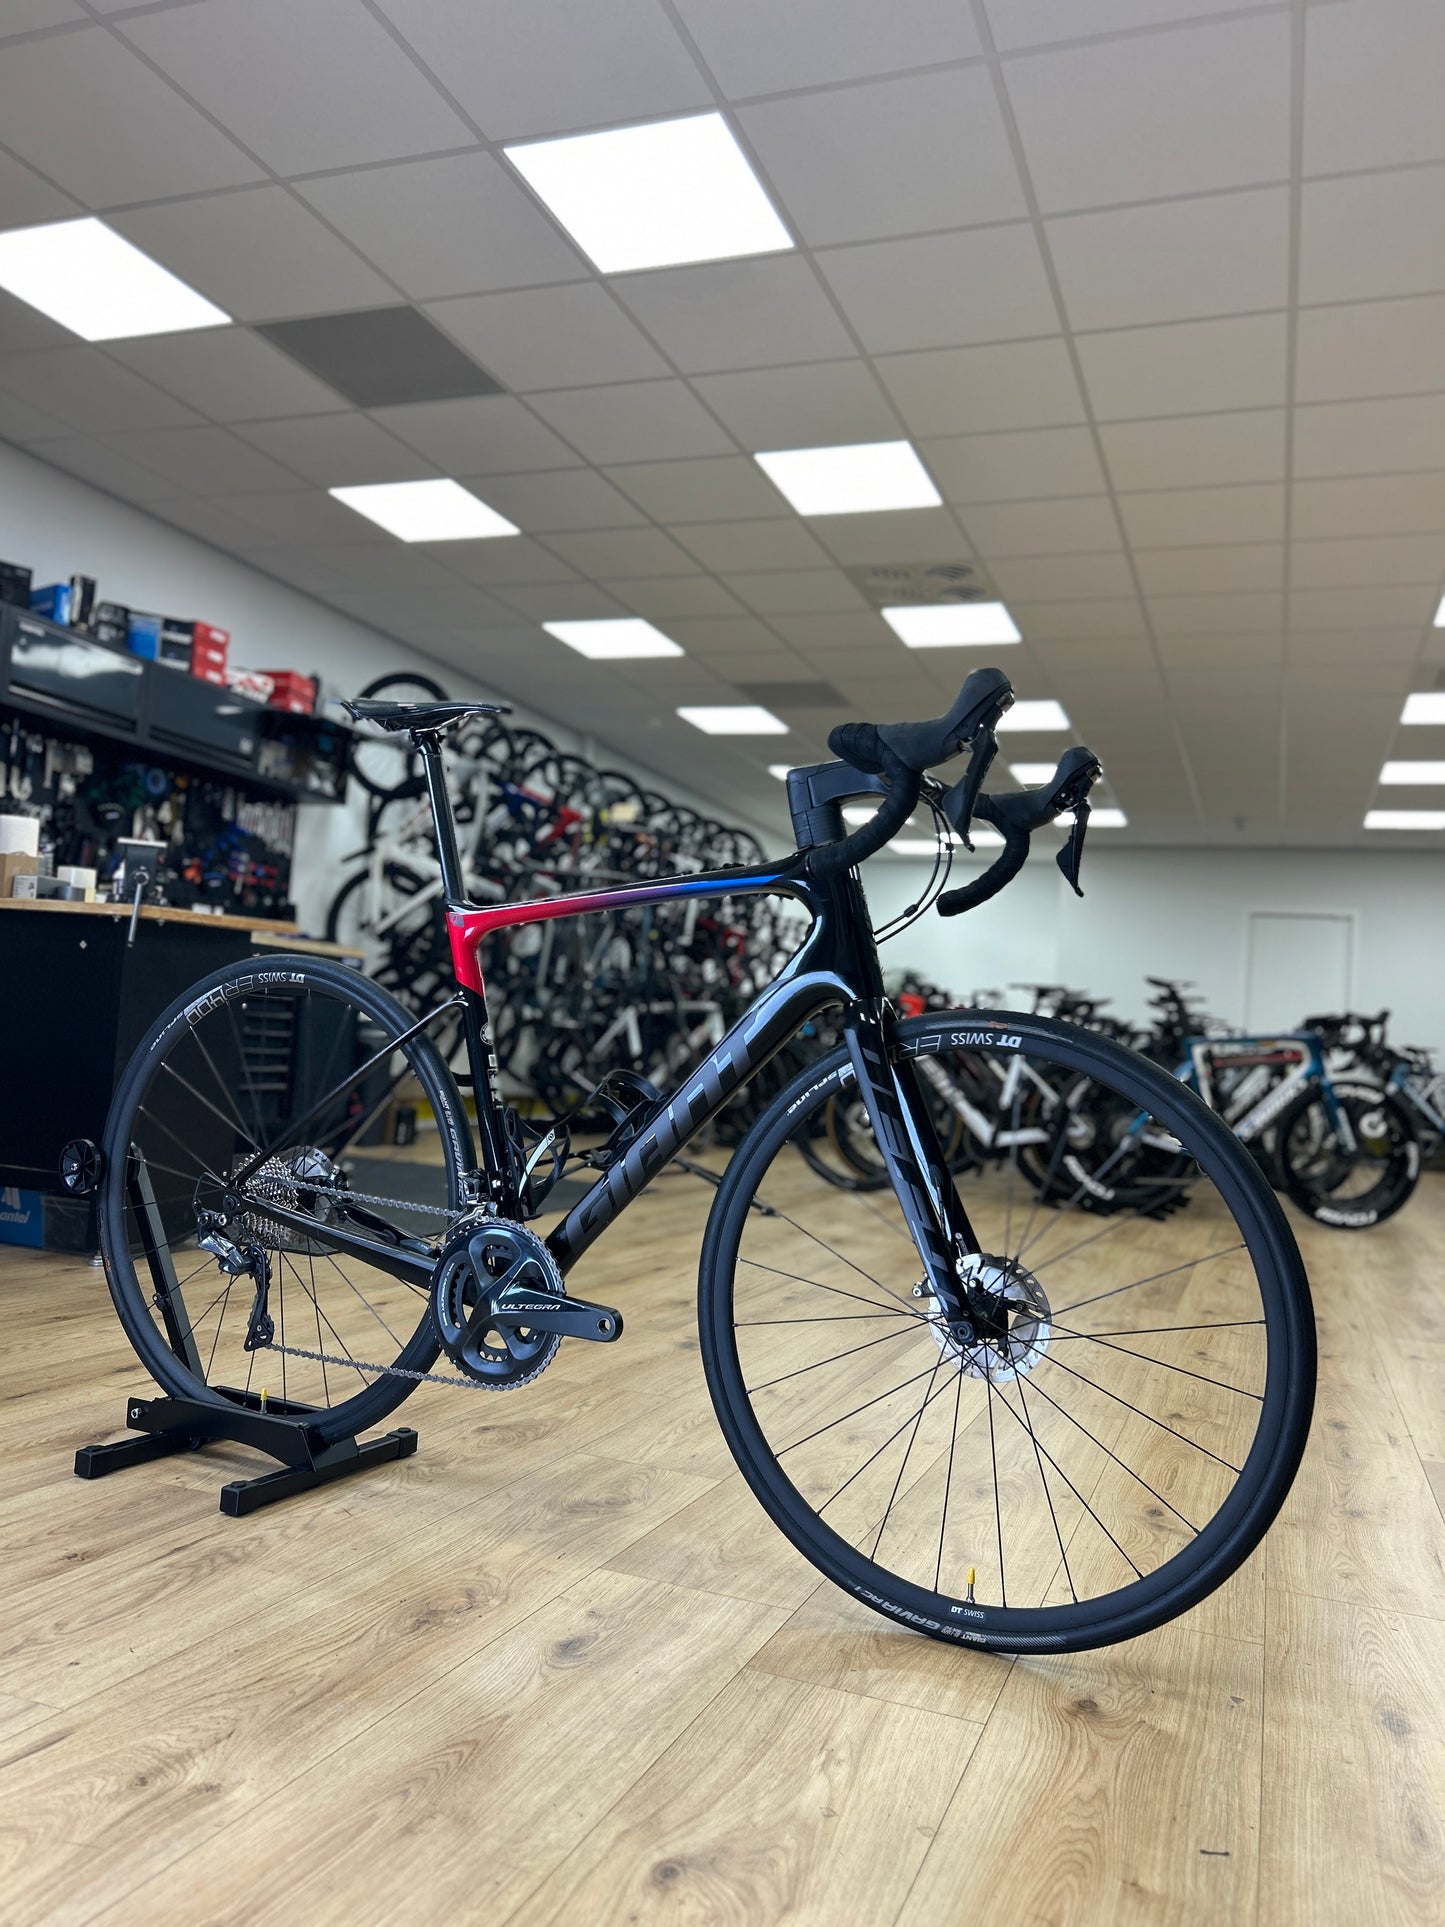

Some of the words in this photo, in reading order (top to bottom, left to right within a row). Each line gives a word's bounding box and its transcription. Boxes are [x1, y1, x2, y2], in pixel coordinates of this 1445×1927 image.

[258, 972, 286, 984] SWISS
[289, 973, 305, 984] DT
[951, 1033, 994, 1046] SWISS
[997, 1036, 1022, 1048] DT
[566, 1008, 761, 1250] GIANT
[881, 1602, 941, 1630] GAVIA
[950, 1605, 963, 1614] DT
[963, 1608, 985, 1619] SWISS
